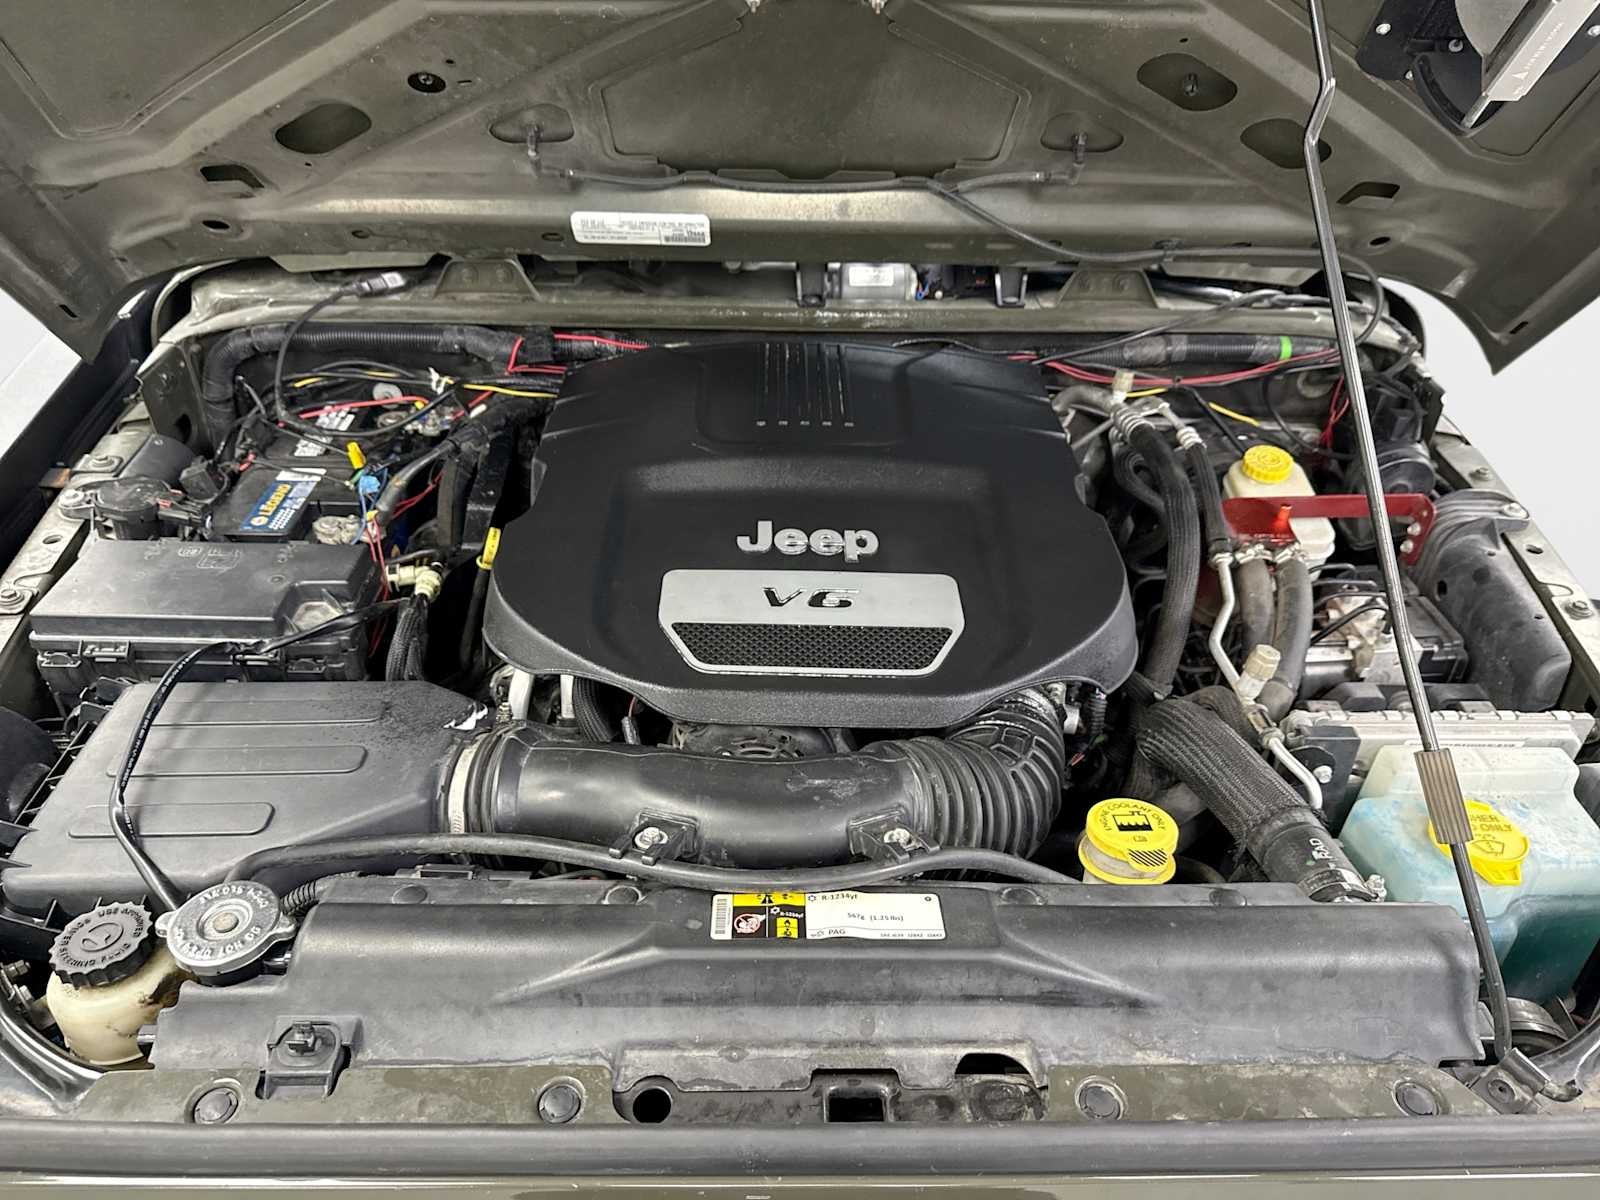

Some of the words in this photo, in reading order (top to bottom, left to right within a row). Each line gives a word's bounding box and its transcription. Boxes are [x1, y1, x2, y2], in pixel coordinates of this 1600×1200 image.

[260, 484, 291, 516] LEGEND
[736, 519, 879, 563] Jeep
[762, 587, 860, 608] V6
[1107, 802, 1151, 814] COOLANT
[1151, 813, 1166, 831] ONLY
[1480, 823, 1512, 832] ONLY
[821, 893, 859, 901] R-1234yf
[98, 907, 119, 917] USE
